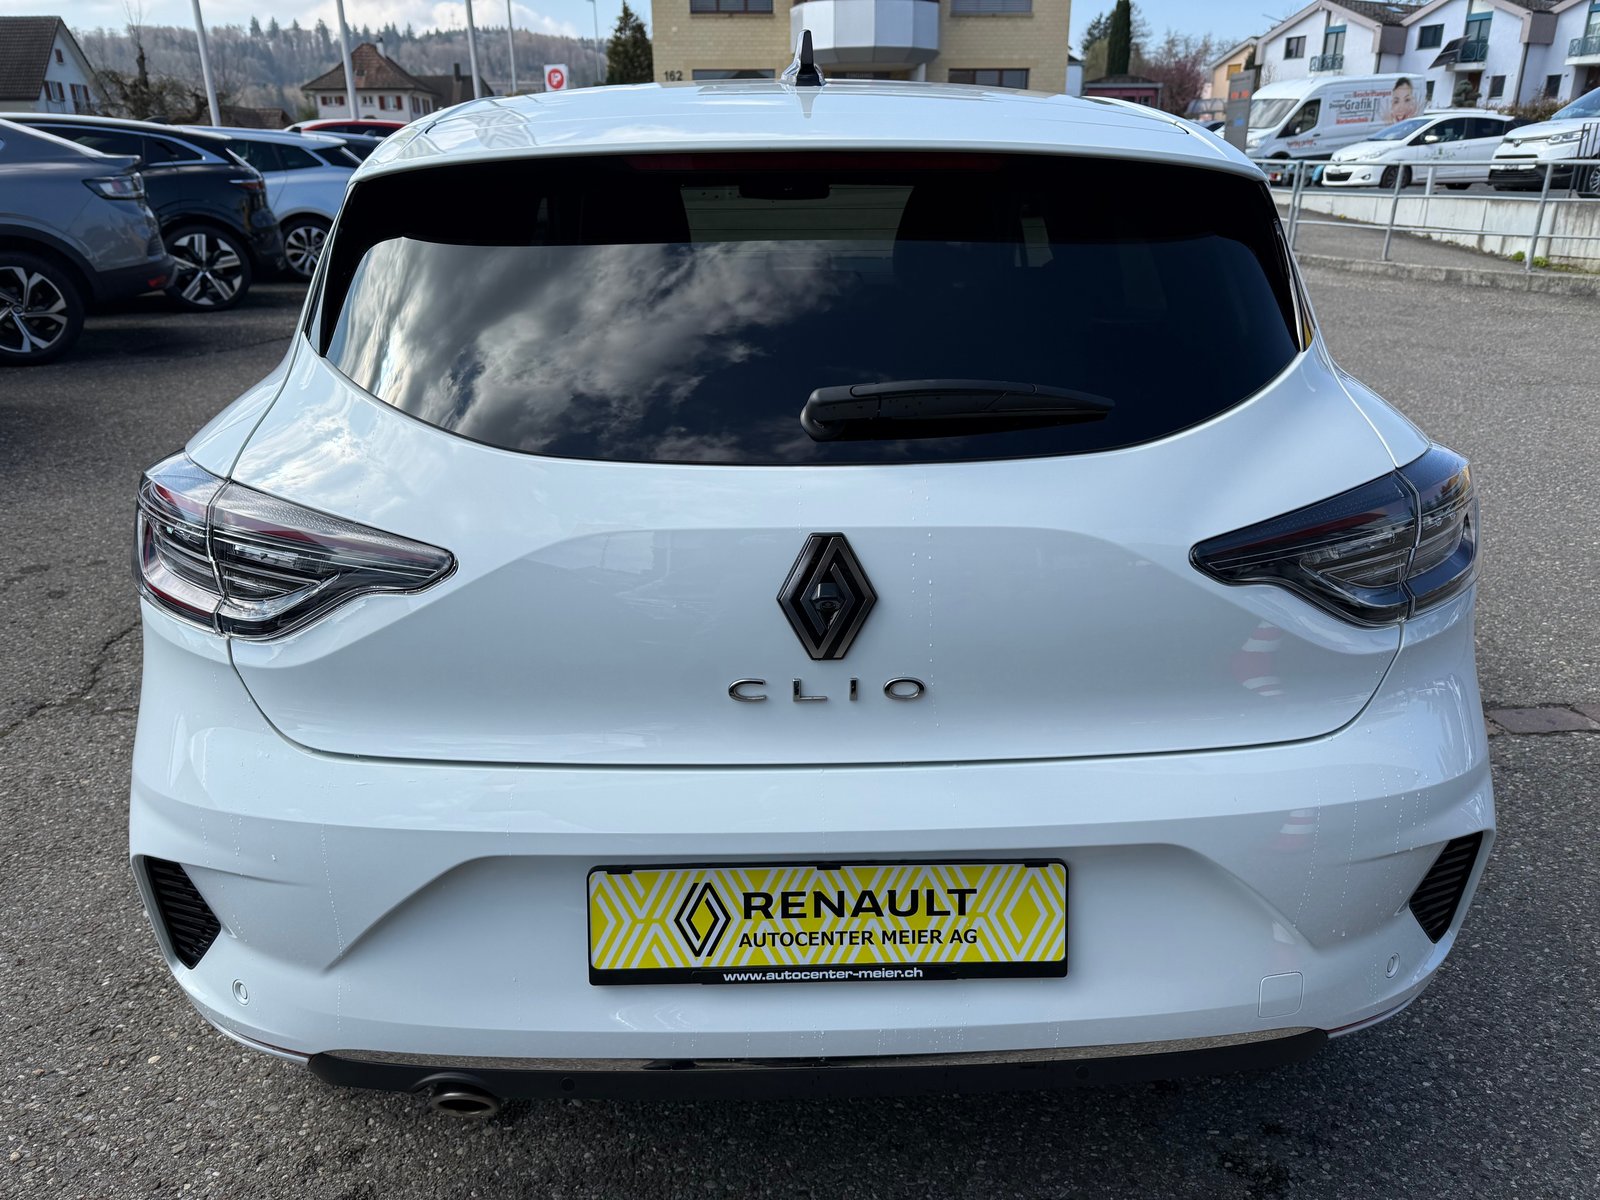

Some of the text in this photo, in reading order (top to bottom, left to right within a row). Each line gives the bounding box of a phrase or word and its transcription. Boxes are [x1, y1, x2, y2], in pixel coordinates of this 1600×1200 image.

[664, 70, 683, 81] 162
[1345, 98, 1372, 110] Grafik
[728, 677, 926, 702] CLIO
[743, 888, 977, 920] RENAULT
[739, 929, 978, 948] AUTOCENTER MEIER AG
[723, 967, 923, 981] www.autocenter-meier.ch
